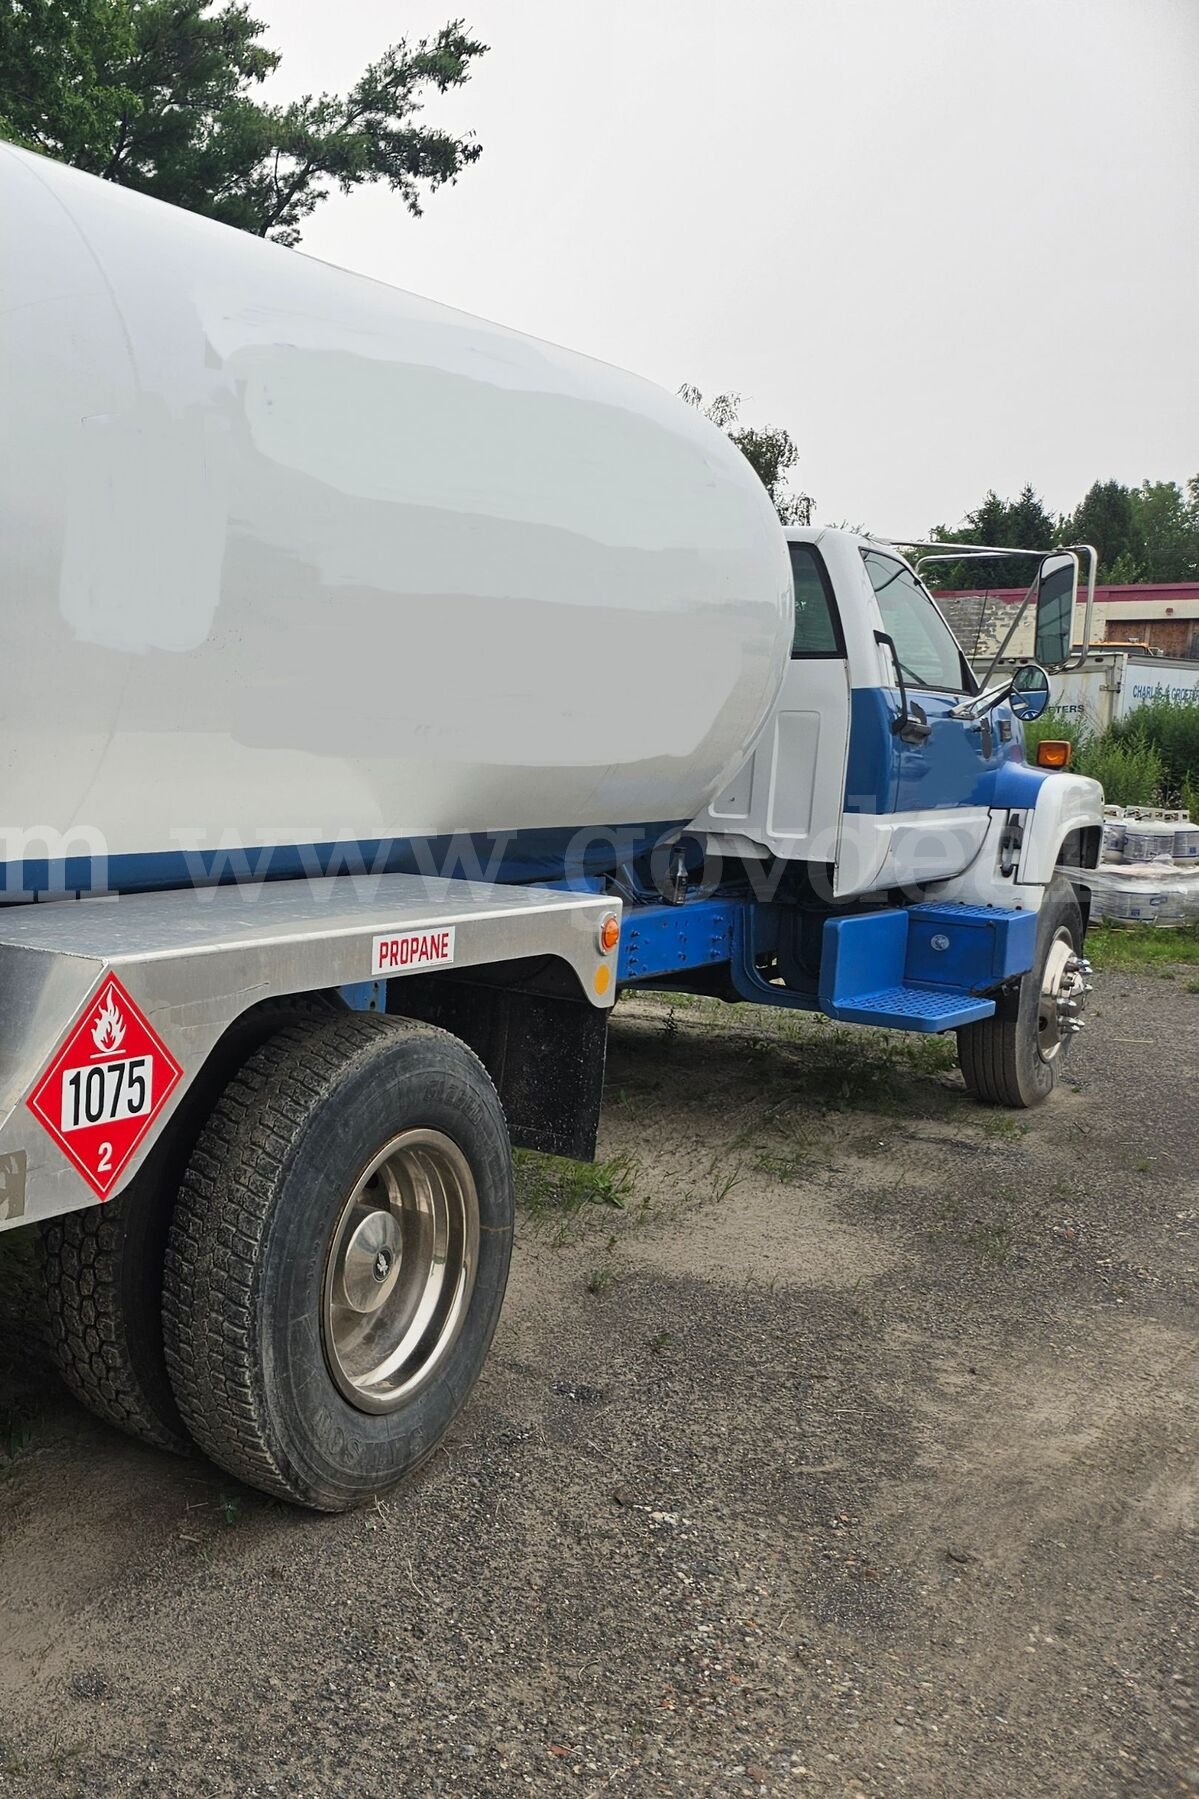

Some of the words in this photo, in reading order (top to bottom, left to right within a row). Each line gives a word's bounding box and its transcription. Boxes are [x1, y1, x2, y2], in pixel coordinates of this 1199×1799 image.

[379, 933, 449, 968] PROPANE
[69, 1059, 146, 1126] 1075
[97, 1142, 113, 1172] 2
